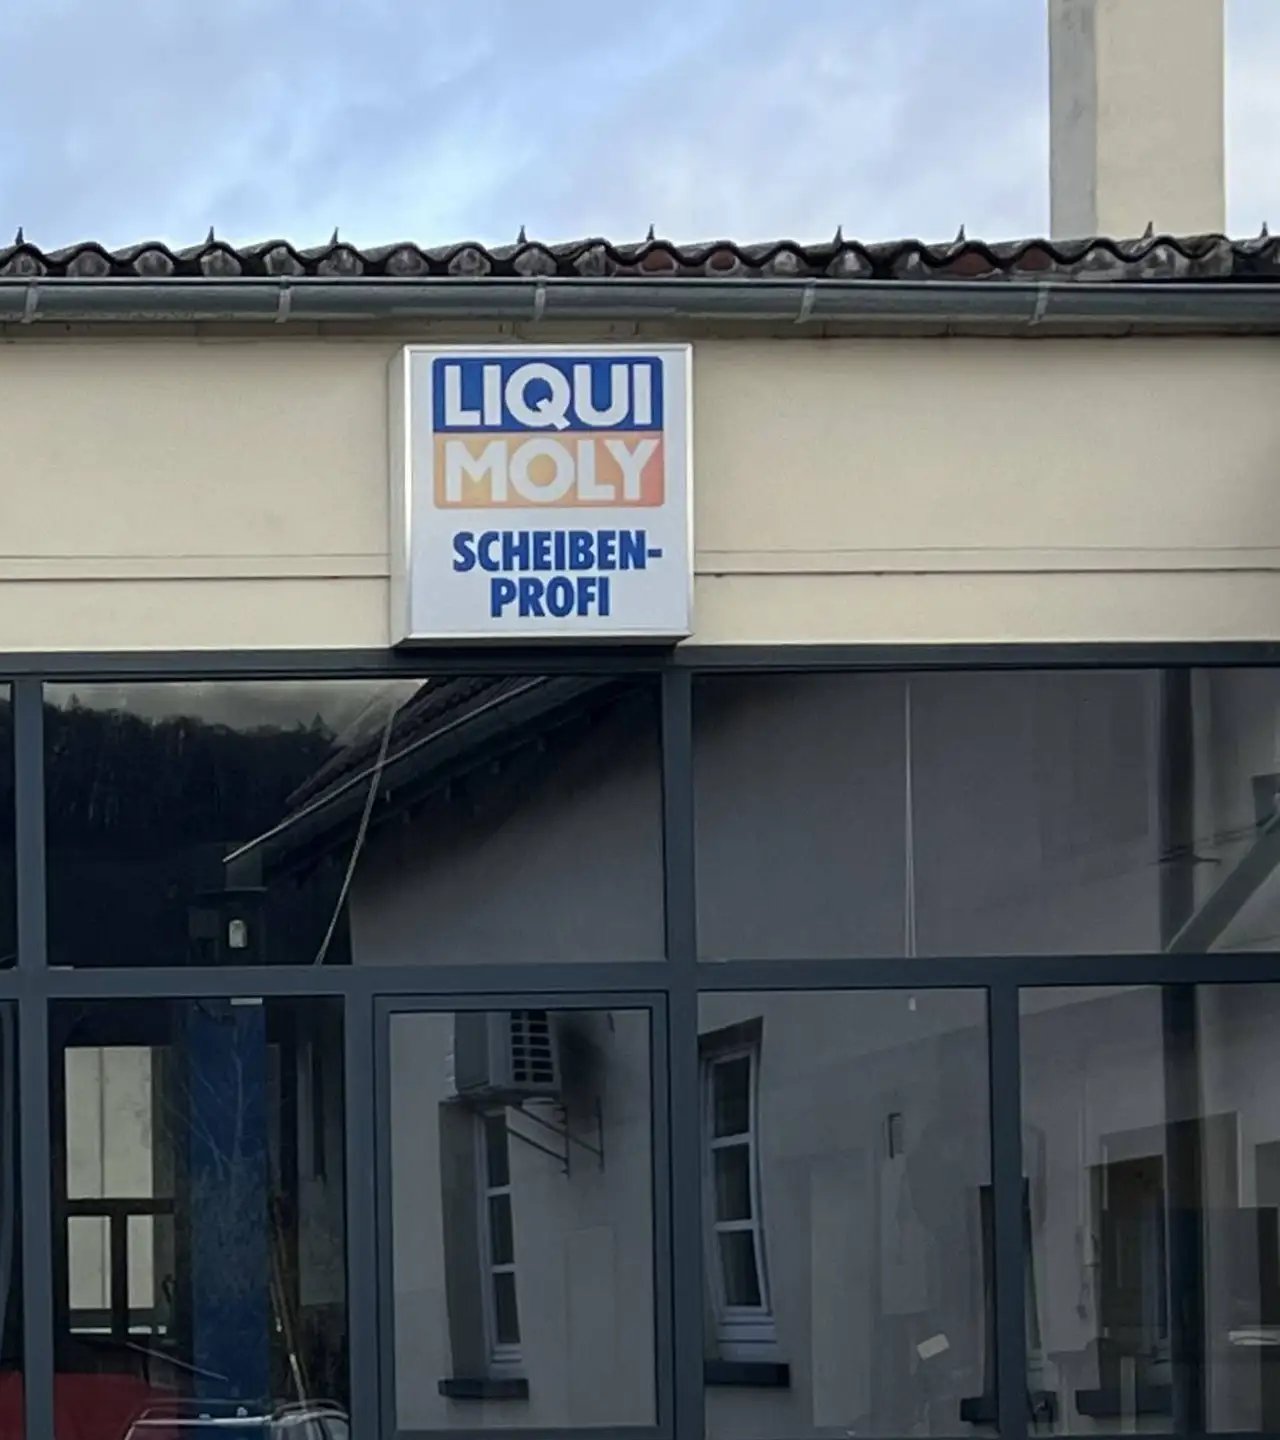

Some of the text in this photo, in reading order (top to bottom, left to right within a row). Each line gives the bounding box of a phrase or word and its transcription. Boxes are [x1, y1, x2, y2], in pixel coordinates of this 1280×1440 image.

[444, 363, 652, 430] LIQUI
[444, 438, 660, 502] MOLY
[452, 530, 662, 572] SCHEIBEN-
[491, 576, 609, 618] PROFI
